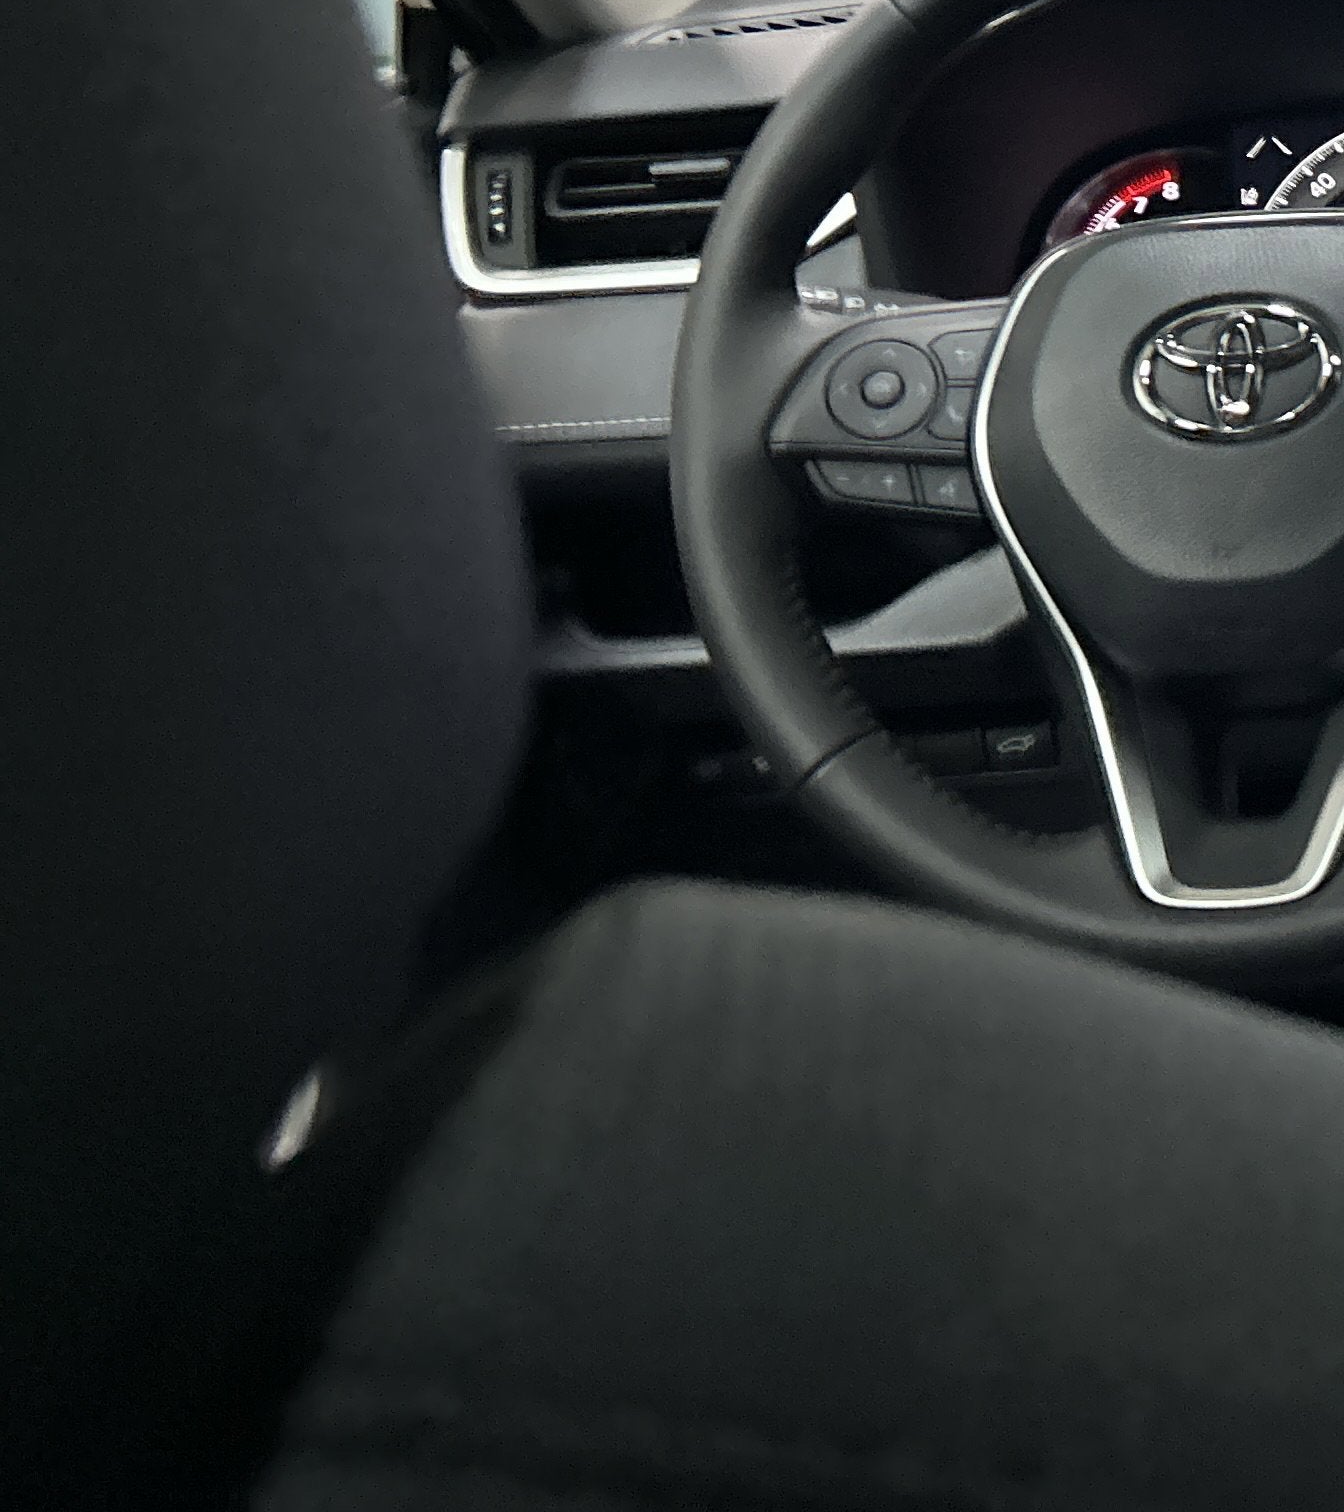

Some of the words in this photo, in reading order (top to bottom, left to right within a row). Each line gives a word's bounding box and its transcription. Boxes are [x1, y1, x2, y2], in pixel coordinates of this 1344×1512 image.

[1161, 181, 1180, 201] 8
[1310, 172, 1337, 198] 40
[1132, 196, 1149, 214] 7
